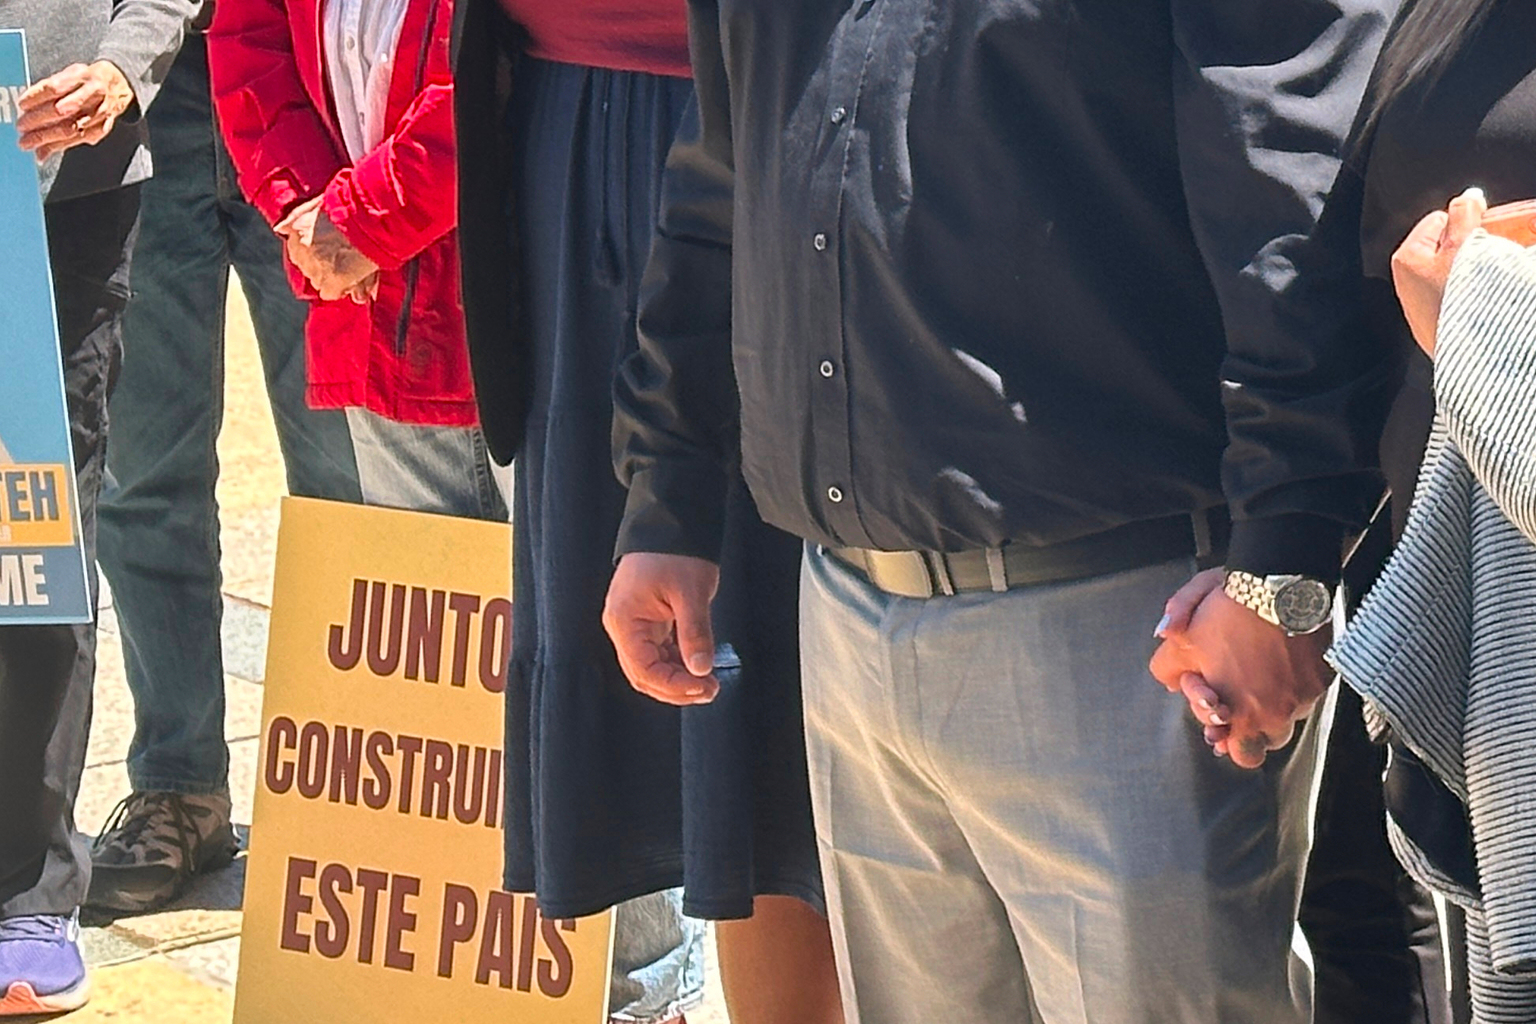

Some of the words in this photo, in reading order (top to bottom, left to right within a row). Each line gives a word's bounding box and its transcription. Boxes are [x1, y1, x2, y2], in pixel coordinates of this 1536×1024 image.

[0, 470, 60, 522] EH
[327, 578, 514, 694] JUNTO
[264, 715, 504, 830] CONSTRUI
[280, 856, 421, 971] ESTE
